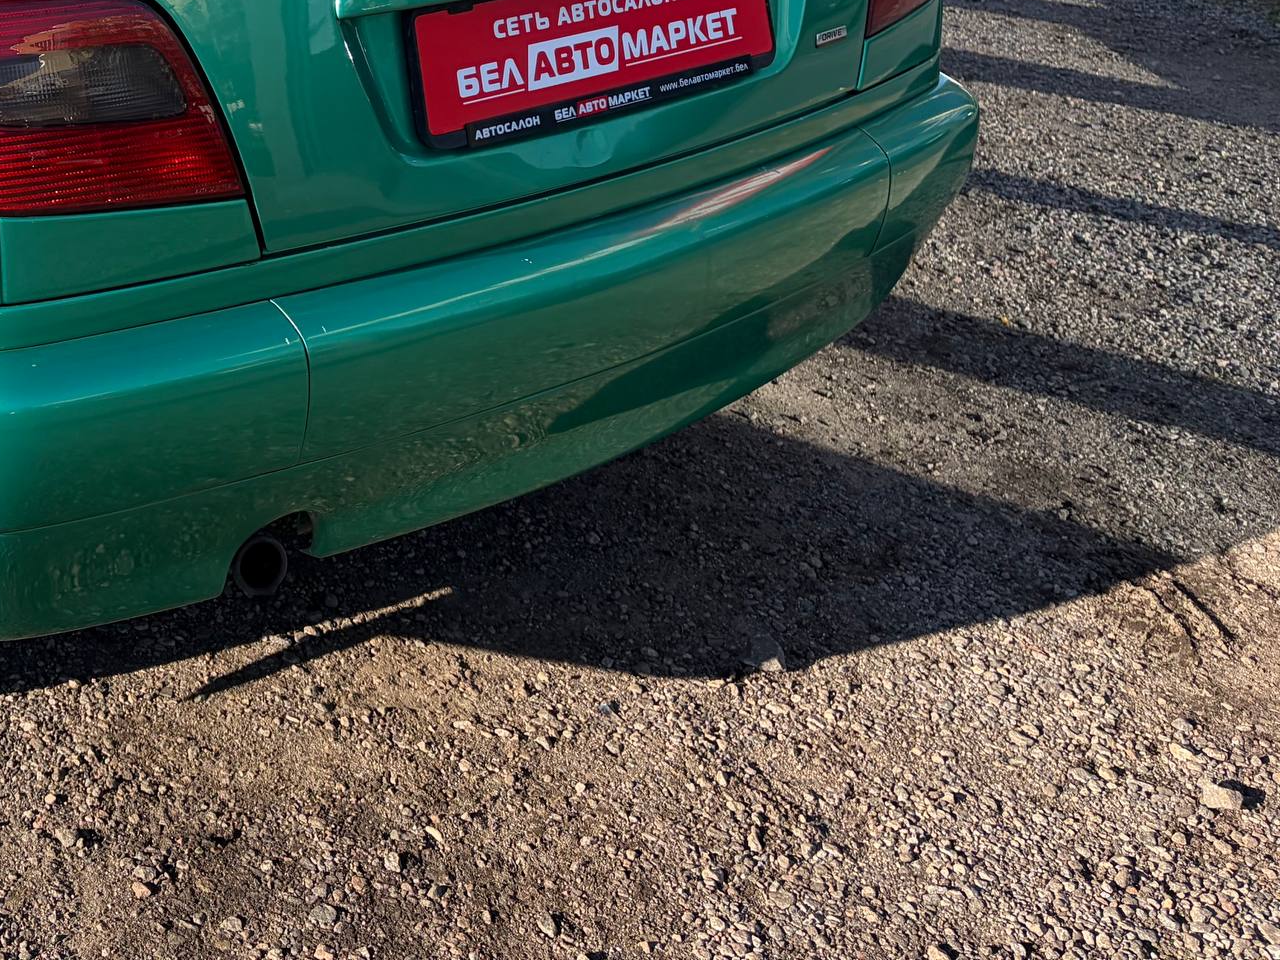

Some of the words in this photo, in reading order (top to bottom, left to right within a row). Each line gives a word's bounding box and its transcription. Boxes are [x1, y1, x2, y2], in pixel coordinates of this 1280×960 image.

[493, 11, 550, 39] СЕТЬ
[475, 115, 541, 141] АВТОСАЛОН
[659, 62, 749, 93] www.белавтомаркет.бел
